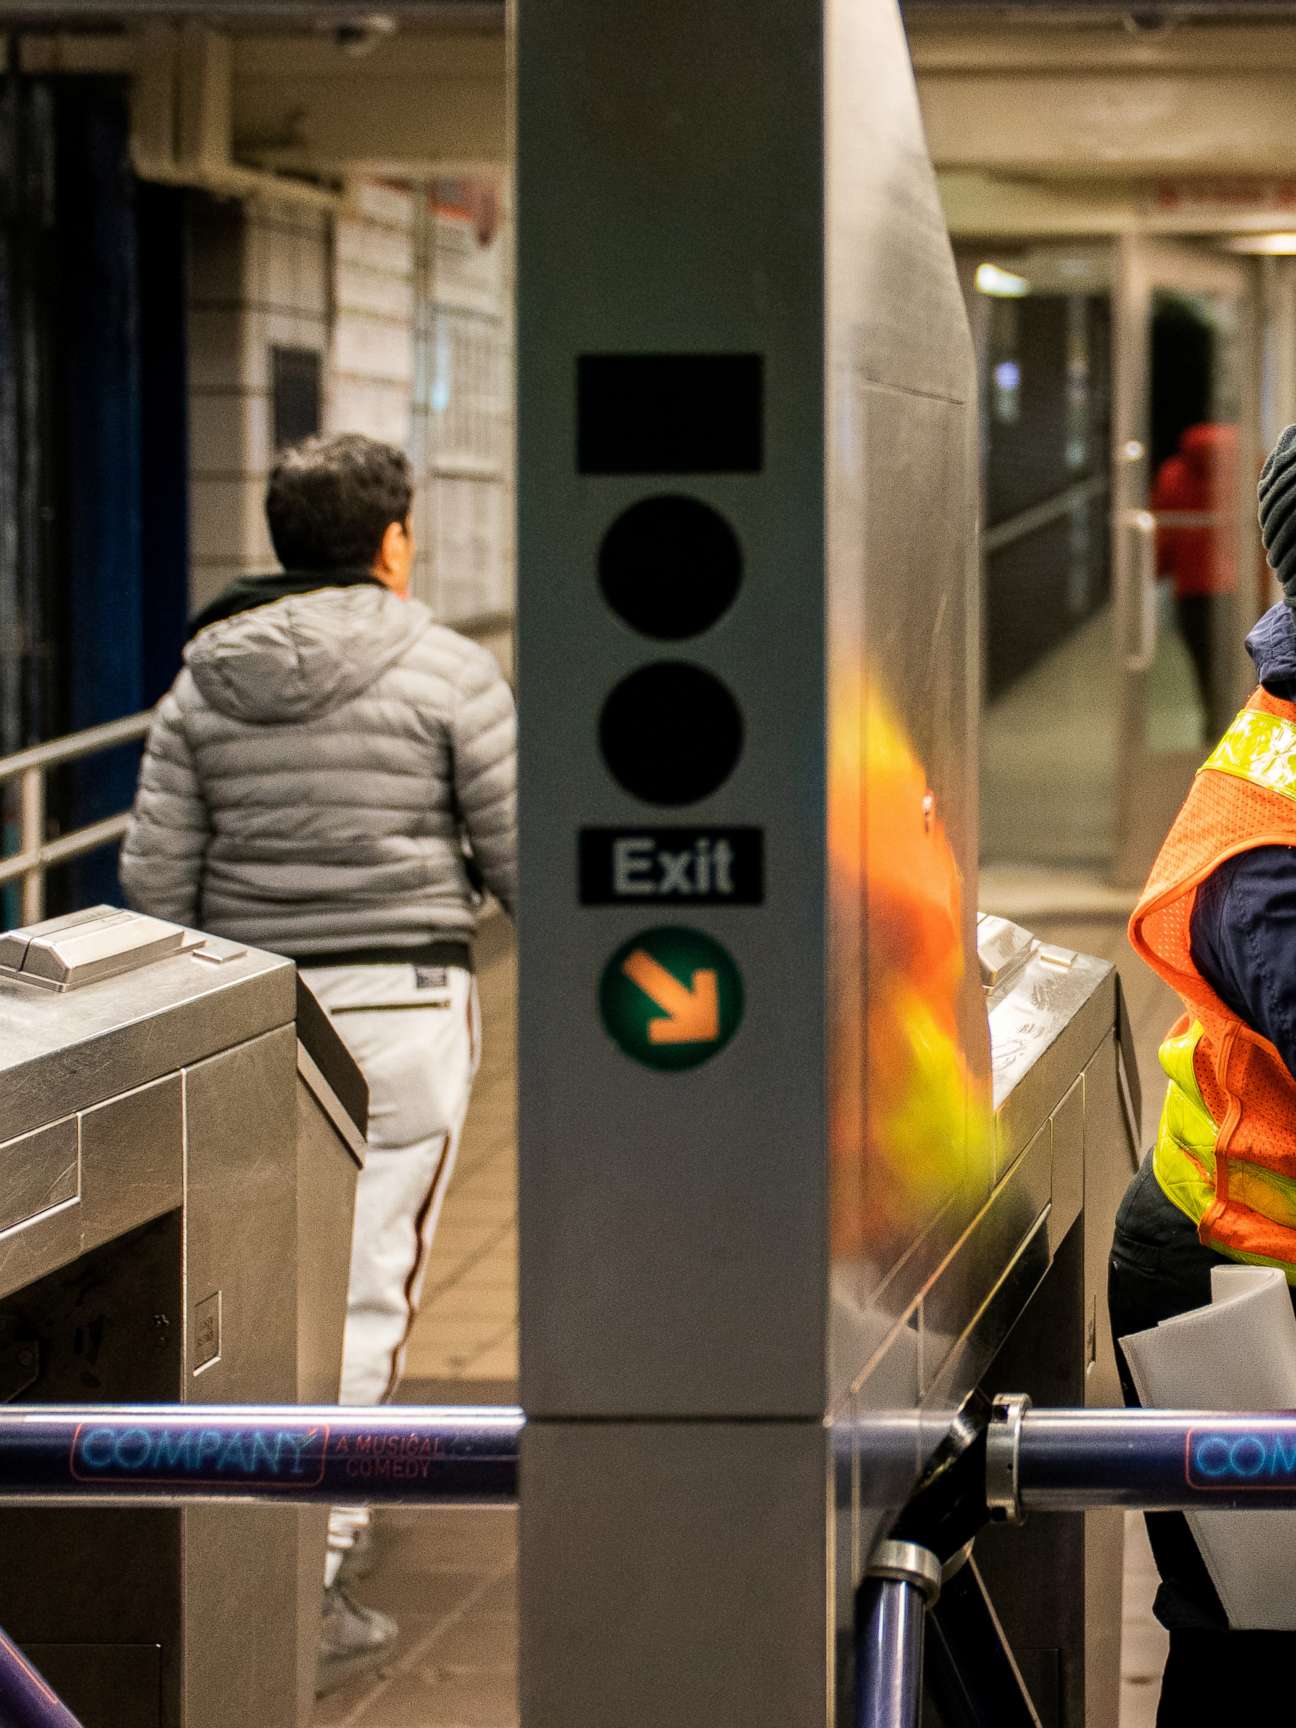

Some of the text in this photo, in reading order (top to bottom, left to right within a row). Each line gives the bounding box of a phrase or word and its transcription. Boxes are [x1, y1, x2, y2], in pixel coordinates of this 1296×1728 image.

[612, 836, 735, 894] Exit
[80, 1426, 317, 1475] COMPANY
[335, 1436, 444, 1456] A MUSICAL
[345, 1458, 432, 1479] COMEDY
